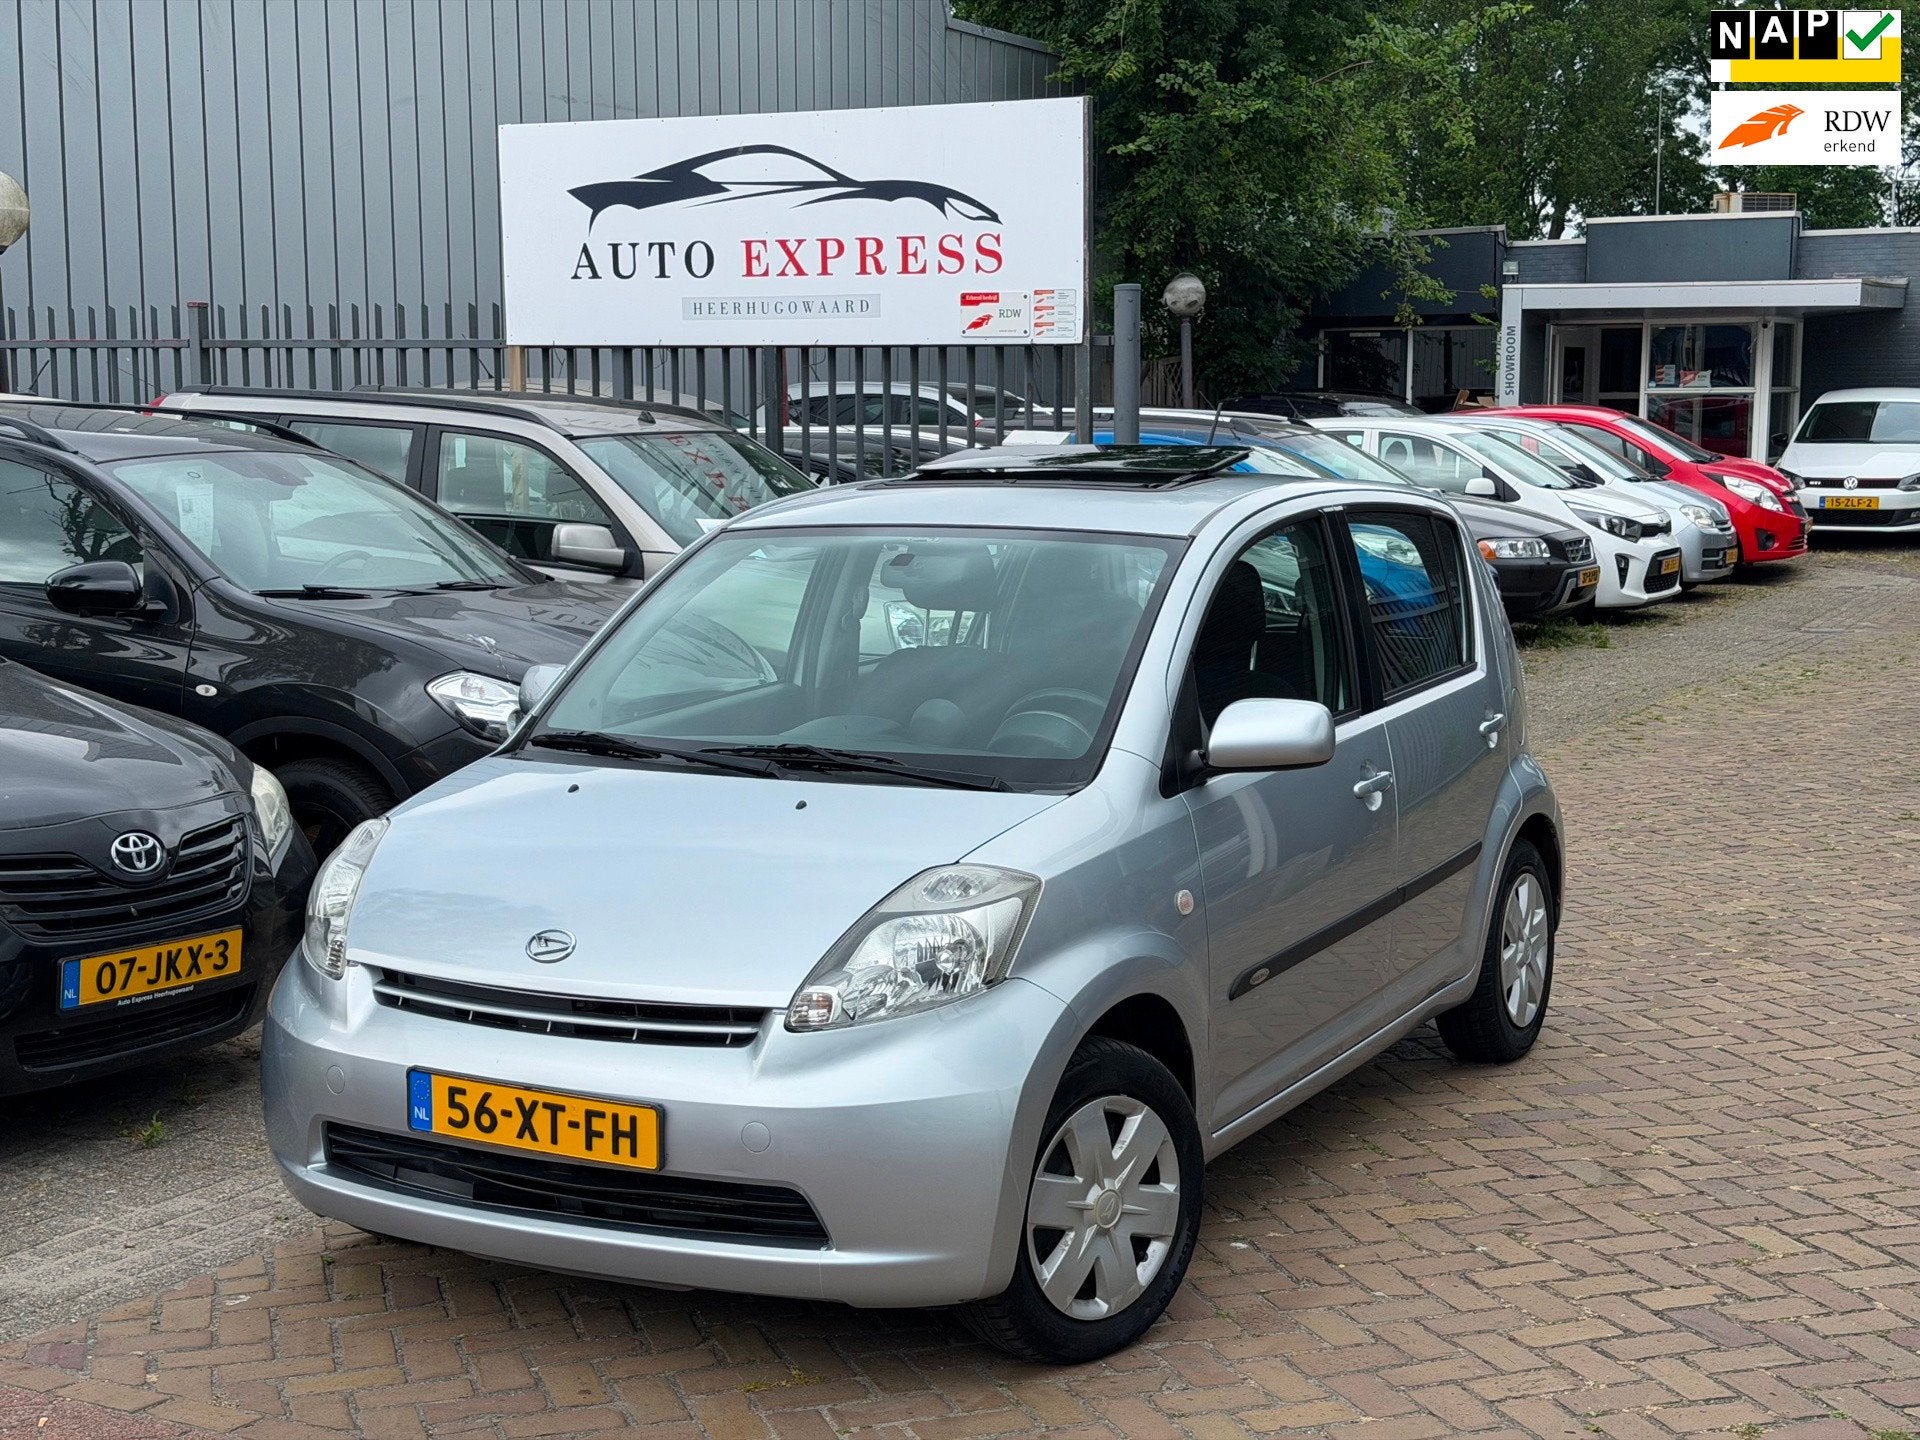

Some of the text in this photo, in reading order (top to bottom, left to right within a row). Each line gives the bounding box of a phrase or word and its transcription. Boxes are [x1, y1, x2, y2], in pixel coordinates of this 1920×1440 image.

[570, 232, 1004, 280] AUTO EXPRESS
[692, 298, 871, 317] HEERHUGOWAARD
[998, 309, 1022, 319] RDW
[1505, 325, 1516, 396] SHOWROOM
[1830, 496, 1873, 508] 15-ZLF-2
[95, 938, 230, 995] 07-JKX-3
[64, 988, 78, 1000] NL
[413, 1106, 430, 1121] NL
[447, 1085, 638, 1158] 56-XT-FH
